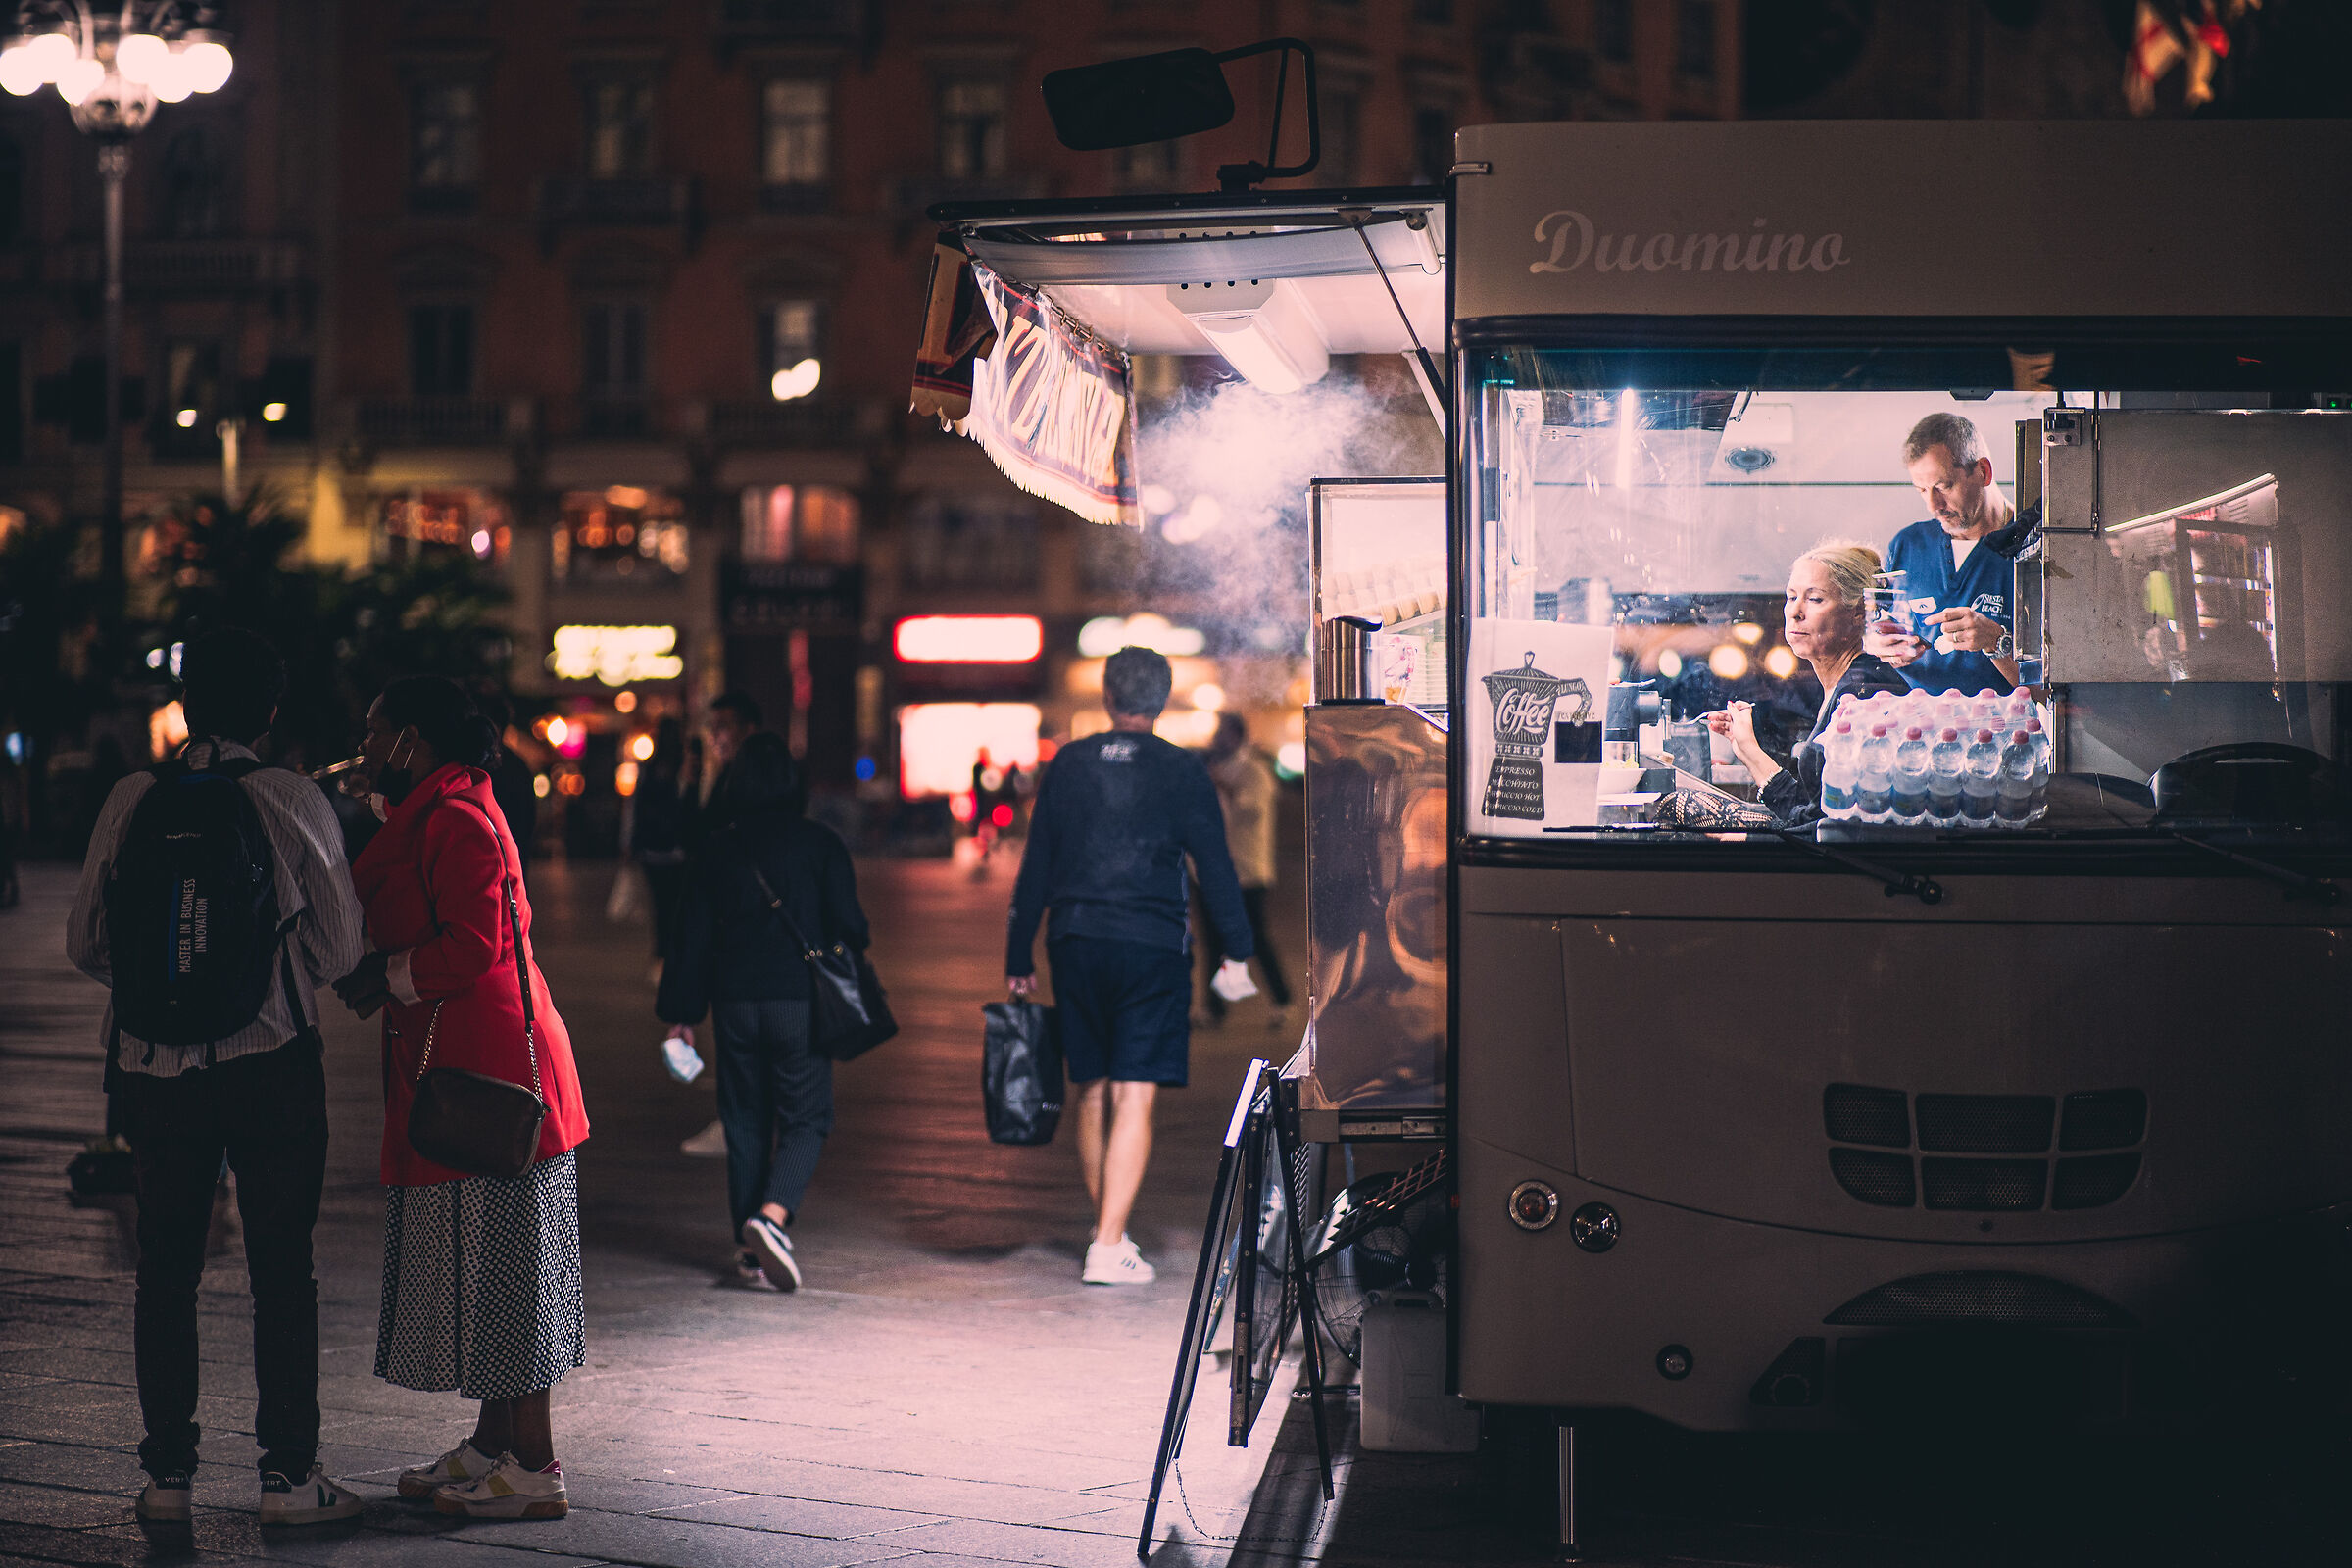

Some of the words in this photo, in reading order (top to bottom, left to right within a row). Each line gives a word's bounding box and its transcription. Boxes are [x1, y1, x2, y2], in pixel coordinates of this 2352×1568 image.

[1529, 209, 1851, 275] Duomino
[1496, 688, 1550, 735] Coffee
[1521, 805, 1543, 813] COLD
[180, 878, 196, 918] BUSINESS
[179, 924, 191, 934] IN
[194, 898, 208, 953] INNOVATION
[178, 938, 191, 973] MASTER
